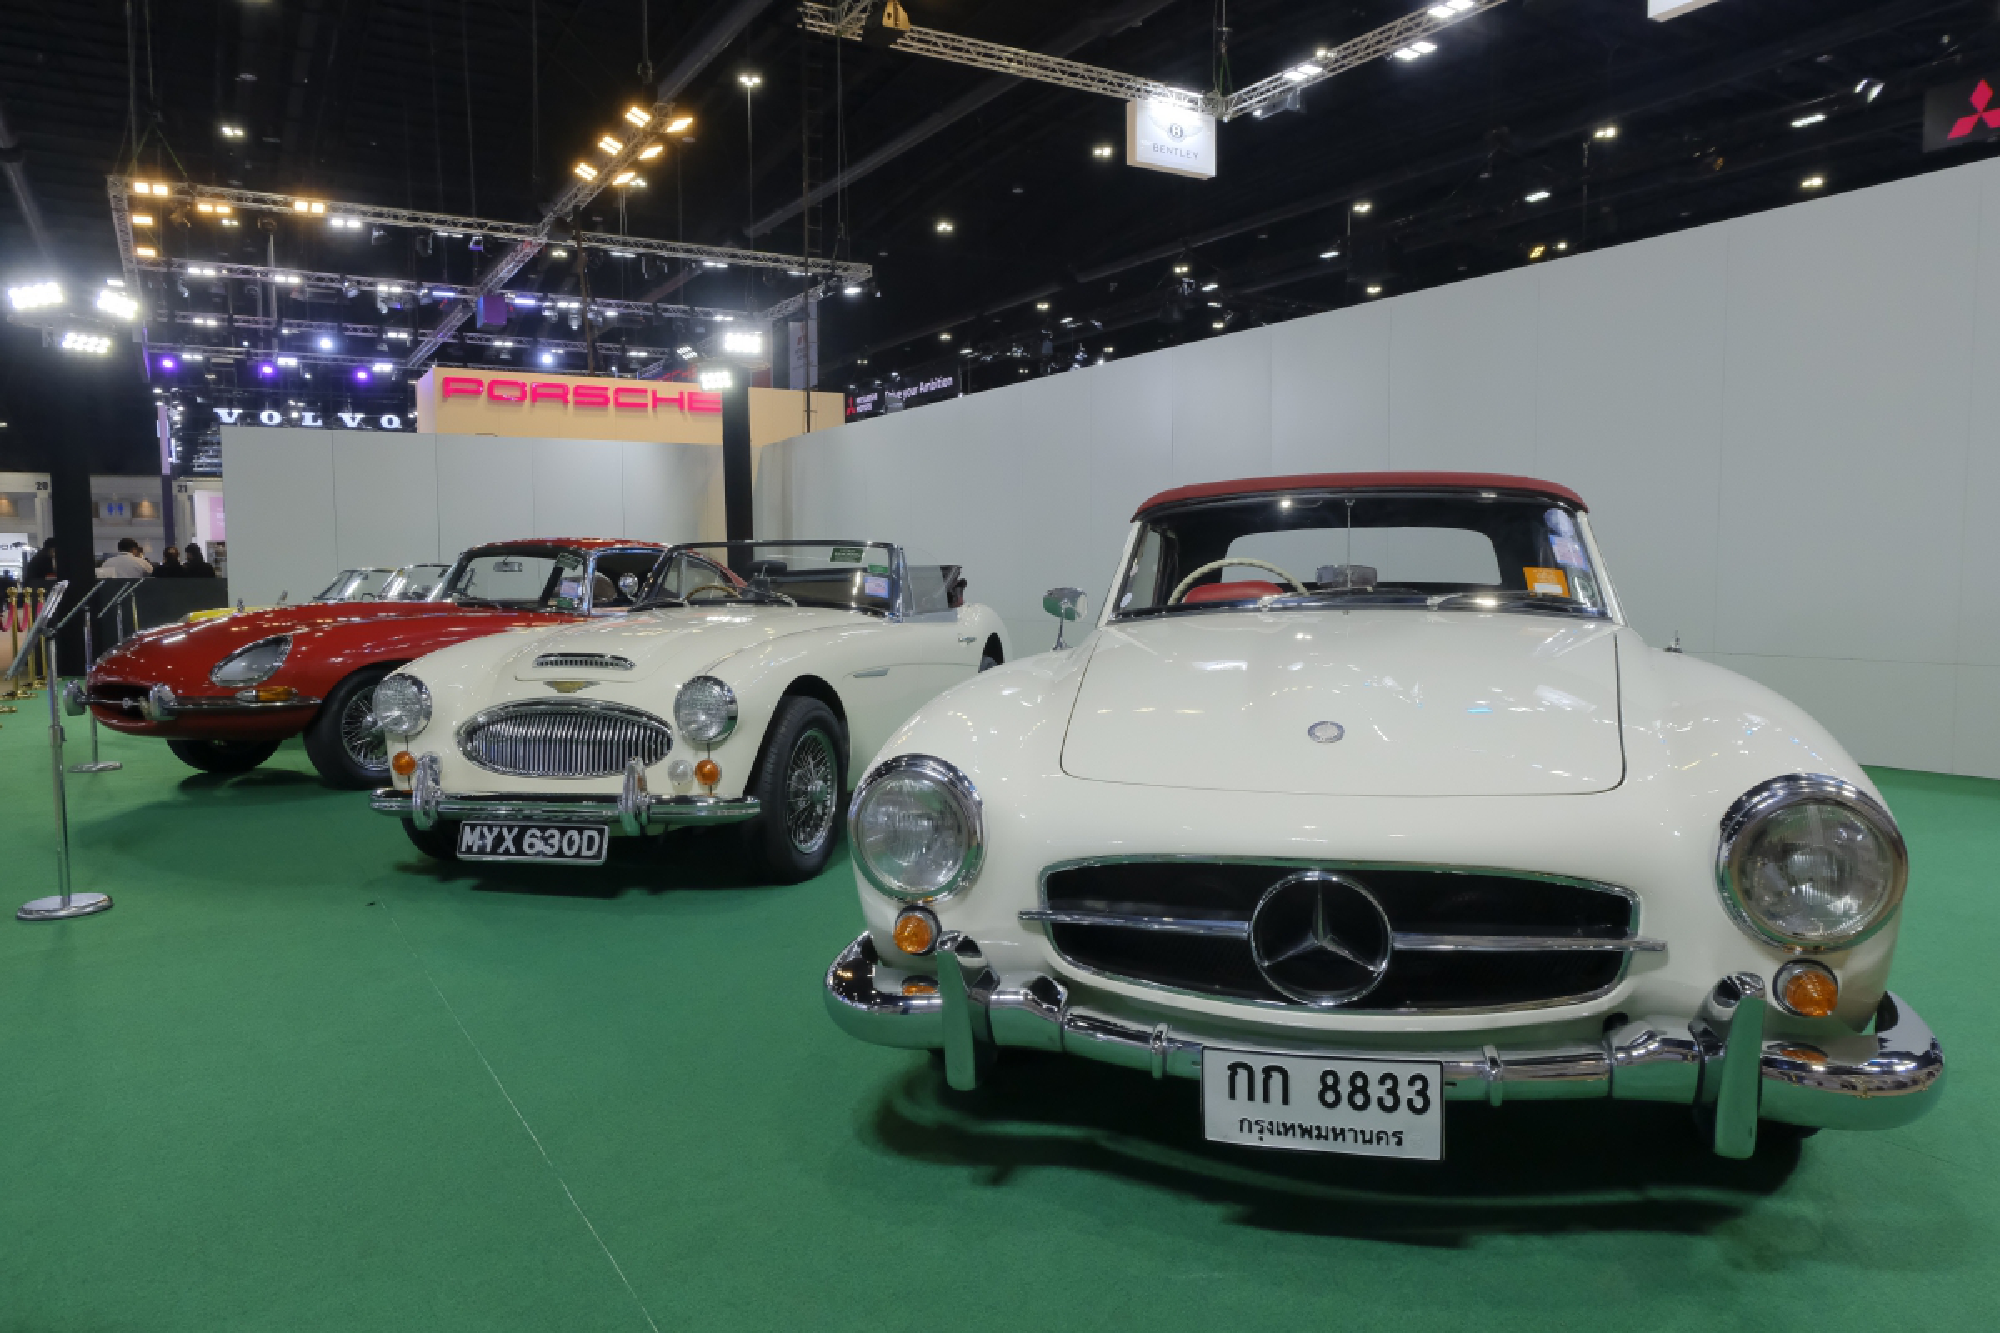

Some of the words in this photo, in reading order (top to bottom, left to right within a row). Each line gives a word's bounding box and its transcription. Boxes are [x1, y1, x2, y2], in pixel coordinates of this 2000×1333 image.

[1152, 143, 1199, 160] BENTLEY
[442, 376, 723, 413] PORSCHE
[213, 407, 403, 429] VOLVO
[461, 825, 518, 854] MYX
[522, 828, 600, 857] 630D
[1227, 1060, 1291, 1106] กก
[1317, 1069, 1431, 1115] 8833
[1238, 1116, 1404, 1147] กรุงเทพมหานคร
